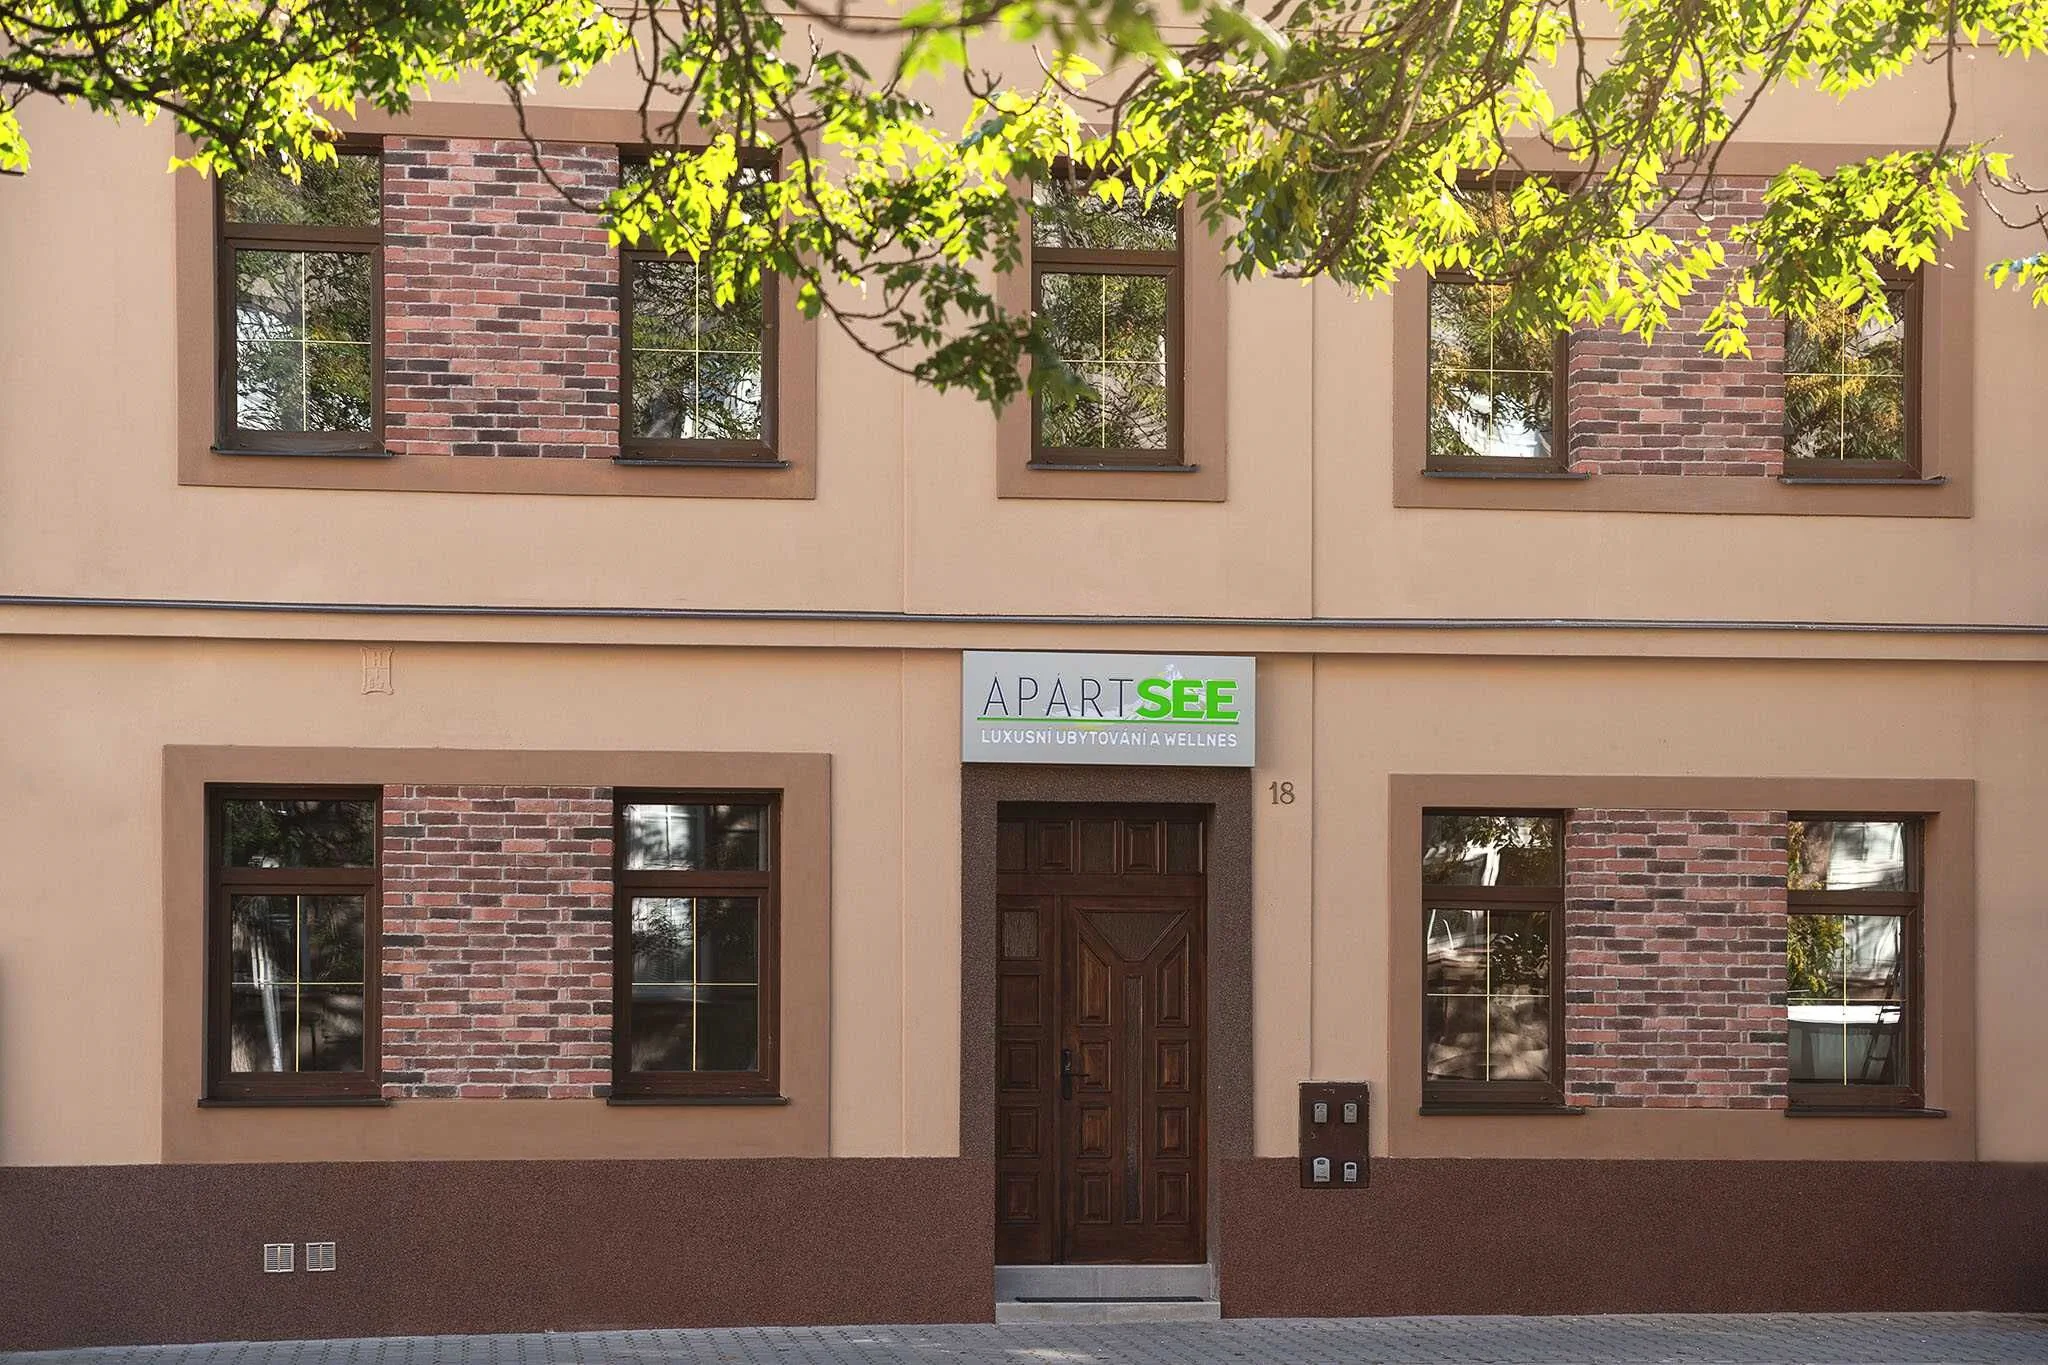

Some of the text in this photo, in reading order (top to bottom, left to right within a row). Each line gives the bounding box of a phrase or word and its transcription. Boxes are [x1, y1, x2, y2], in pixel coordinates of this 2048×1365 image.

[981, 728, 1238, 748] LUXUSNÍ UBYTOVÁNÍ A WELLNES
[1268, 781, 1296, 805] 18
